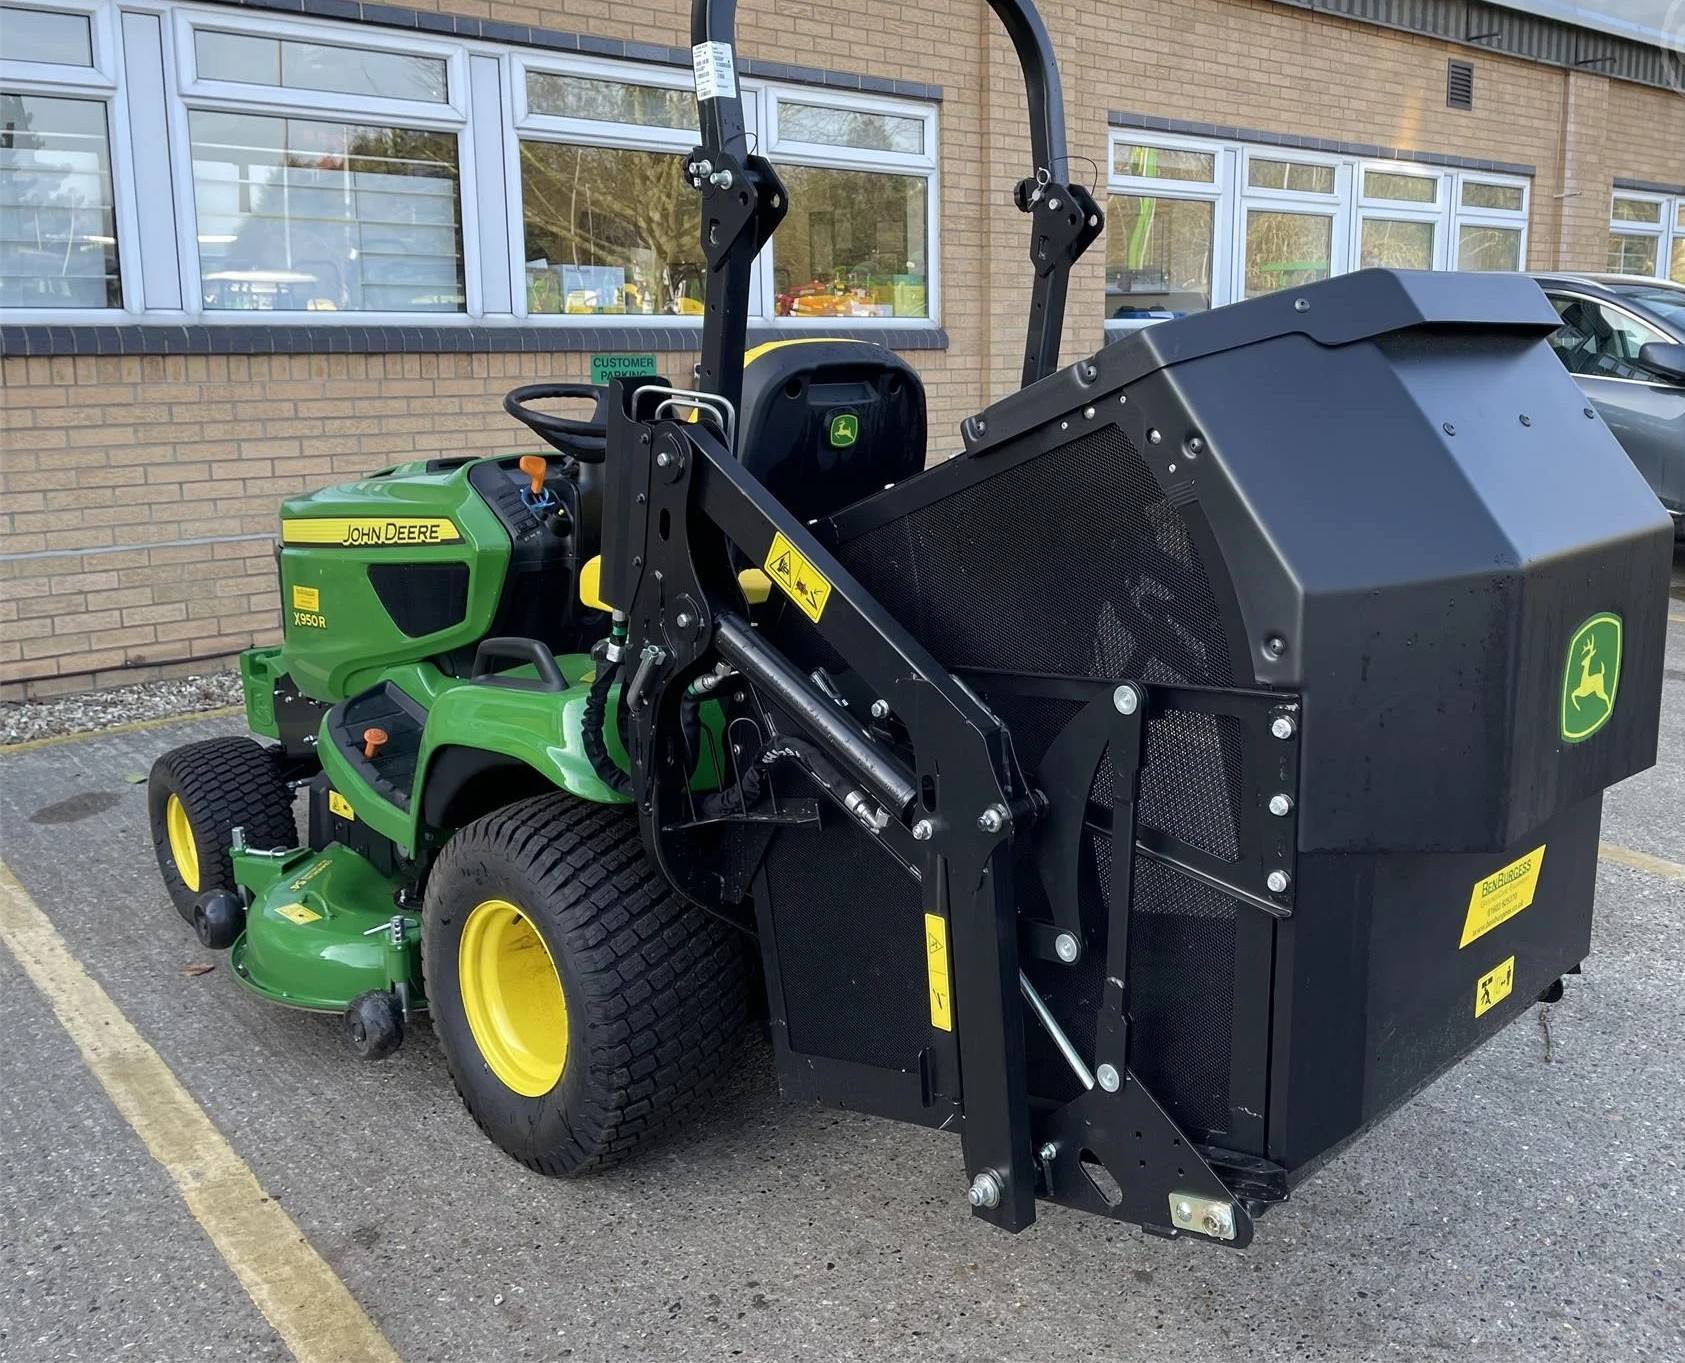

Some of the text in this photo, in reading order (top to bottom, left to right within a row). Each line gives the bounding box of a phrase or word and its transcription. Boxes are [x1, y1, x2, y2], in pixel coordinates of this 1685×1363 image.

[593, 357, 654, 368] CUSTOMER
[343, 523, 440, 542] JOHN DEERE
[293, 612, 326, 628] X950R
